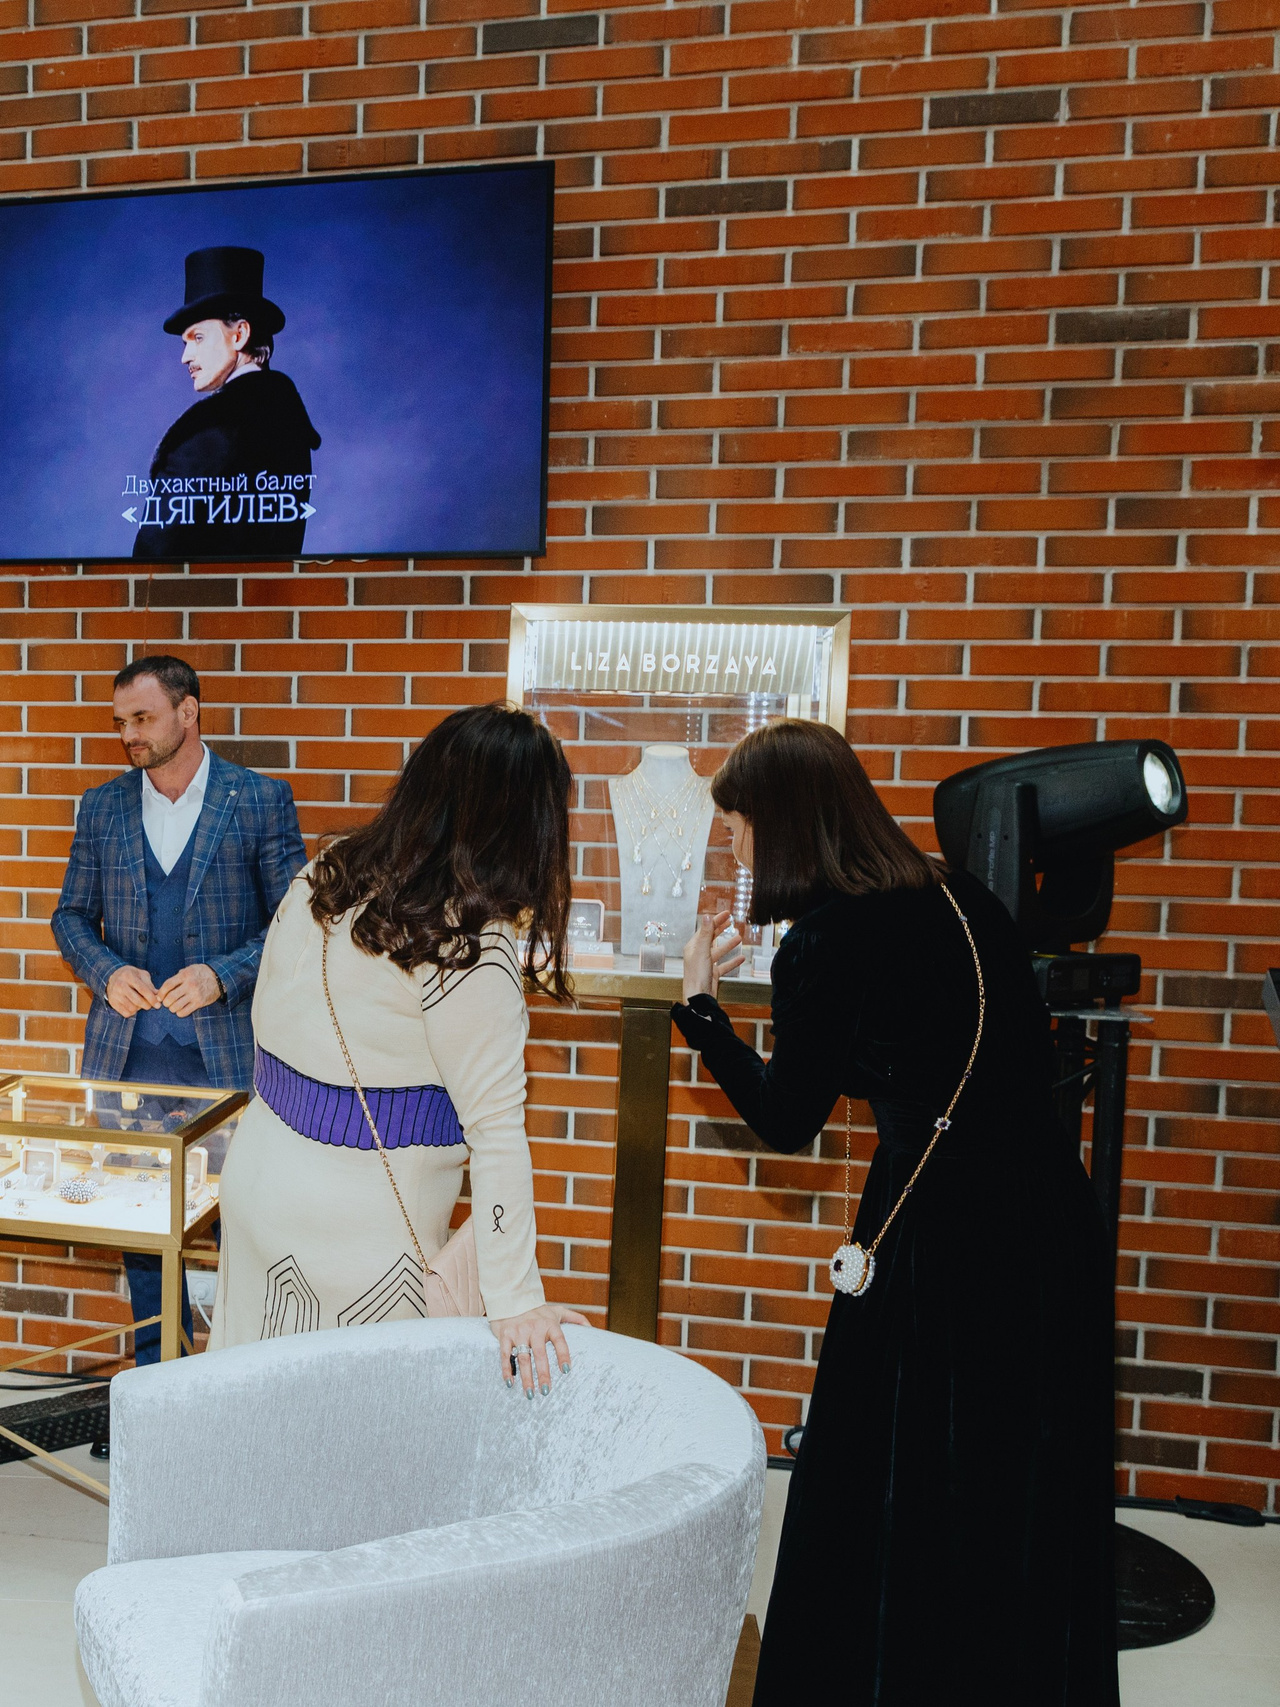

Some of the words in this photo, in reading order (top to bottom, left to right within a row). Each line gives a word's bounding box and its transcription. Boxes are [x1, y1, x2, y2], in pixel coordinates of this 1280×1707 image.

[121, 473, 248, 498] Двухактный
[255, 470, 317, 491] балет
[121, 493, 317, 529] «ДЯГИЛЕВ»
[571, 651, 631, 672] LIZA
[642, 653, 777, 676] BORZAYA
